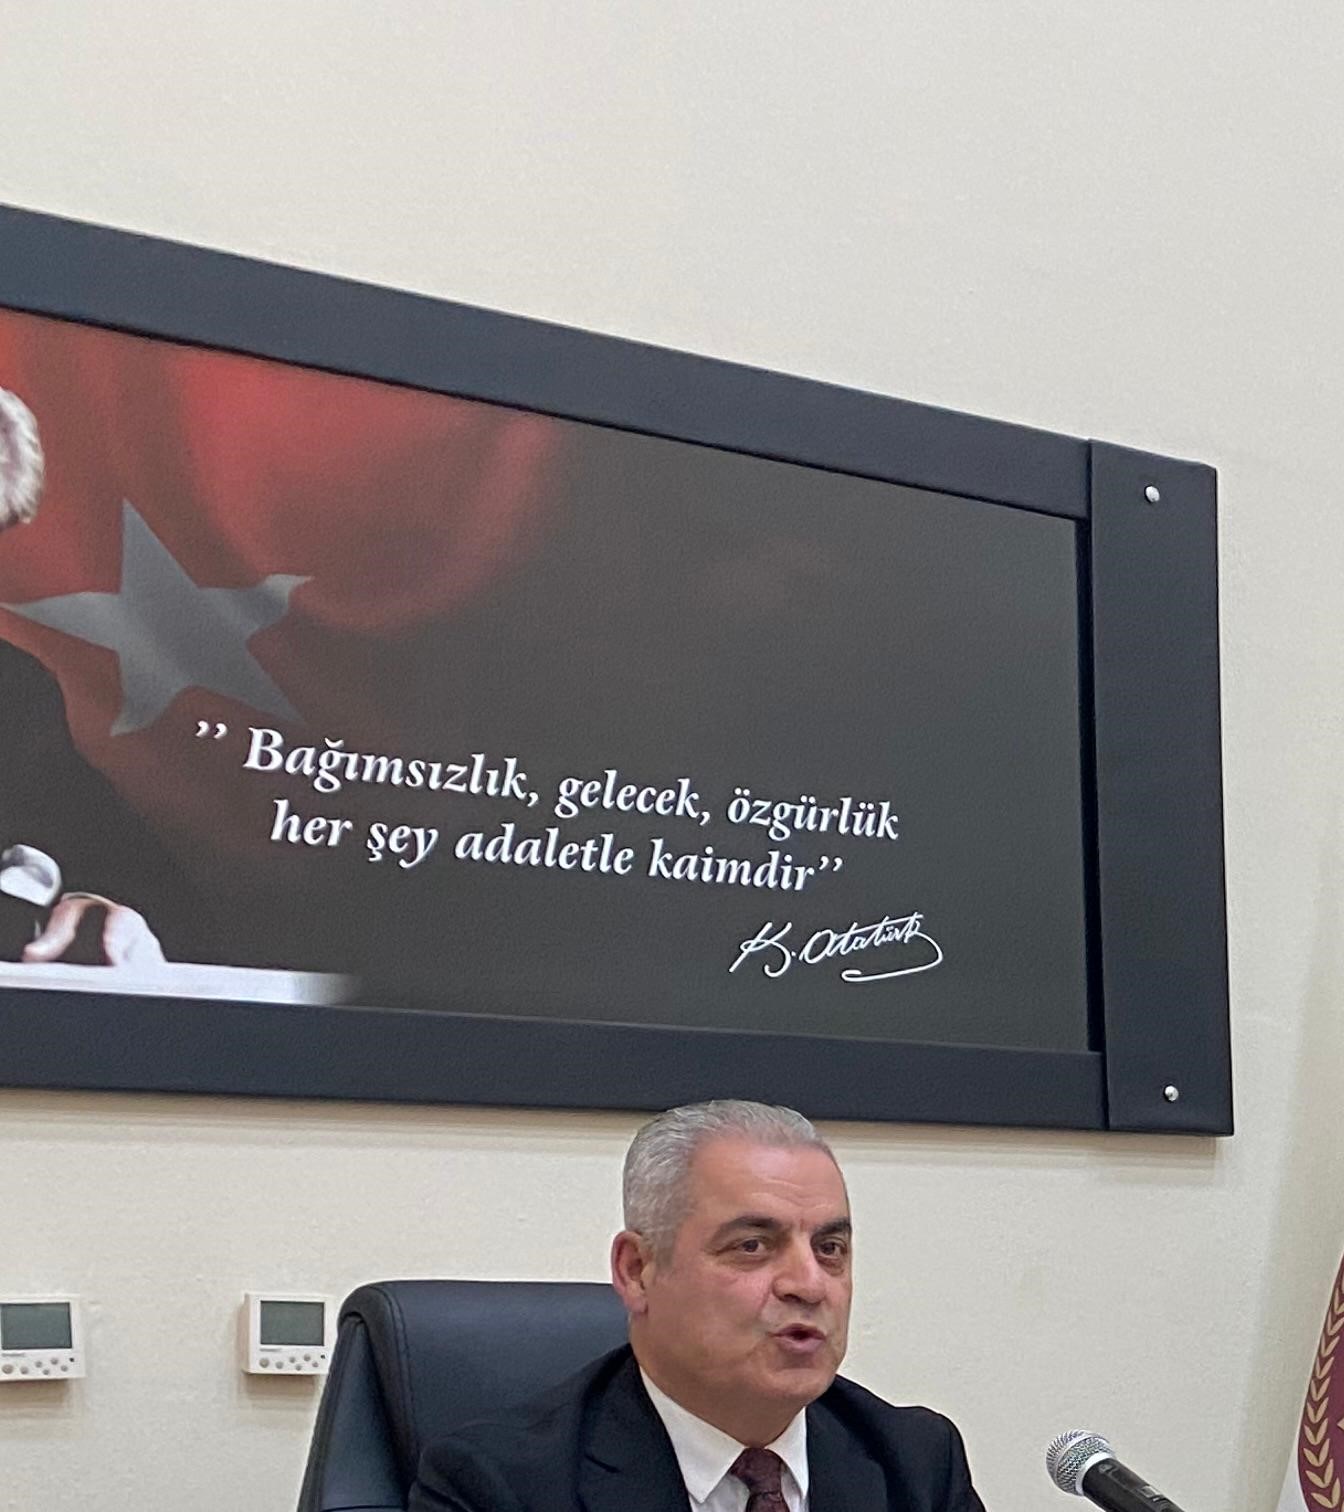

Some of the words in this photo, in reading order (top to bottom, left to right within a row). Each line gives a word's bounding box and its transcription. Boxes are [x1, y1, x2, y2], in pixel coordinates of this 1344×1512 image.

[242, 726, 540, 808] Bağımsızlık,
[554, 769, 712, 828] gelecek,
[727, 787, 900, 842] özgürlük
[270, 799, 353, 848] her
[366, 821, 440, 869] şey
[454, 822, 635, 876] adaletle
